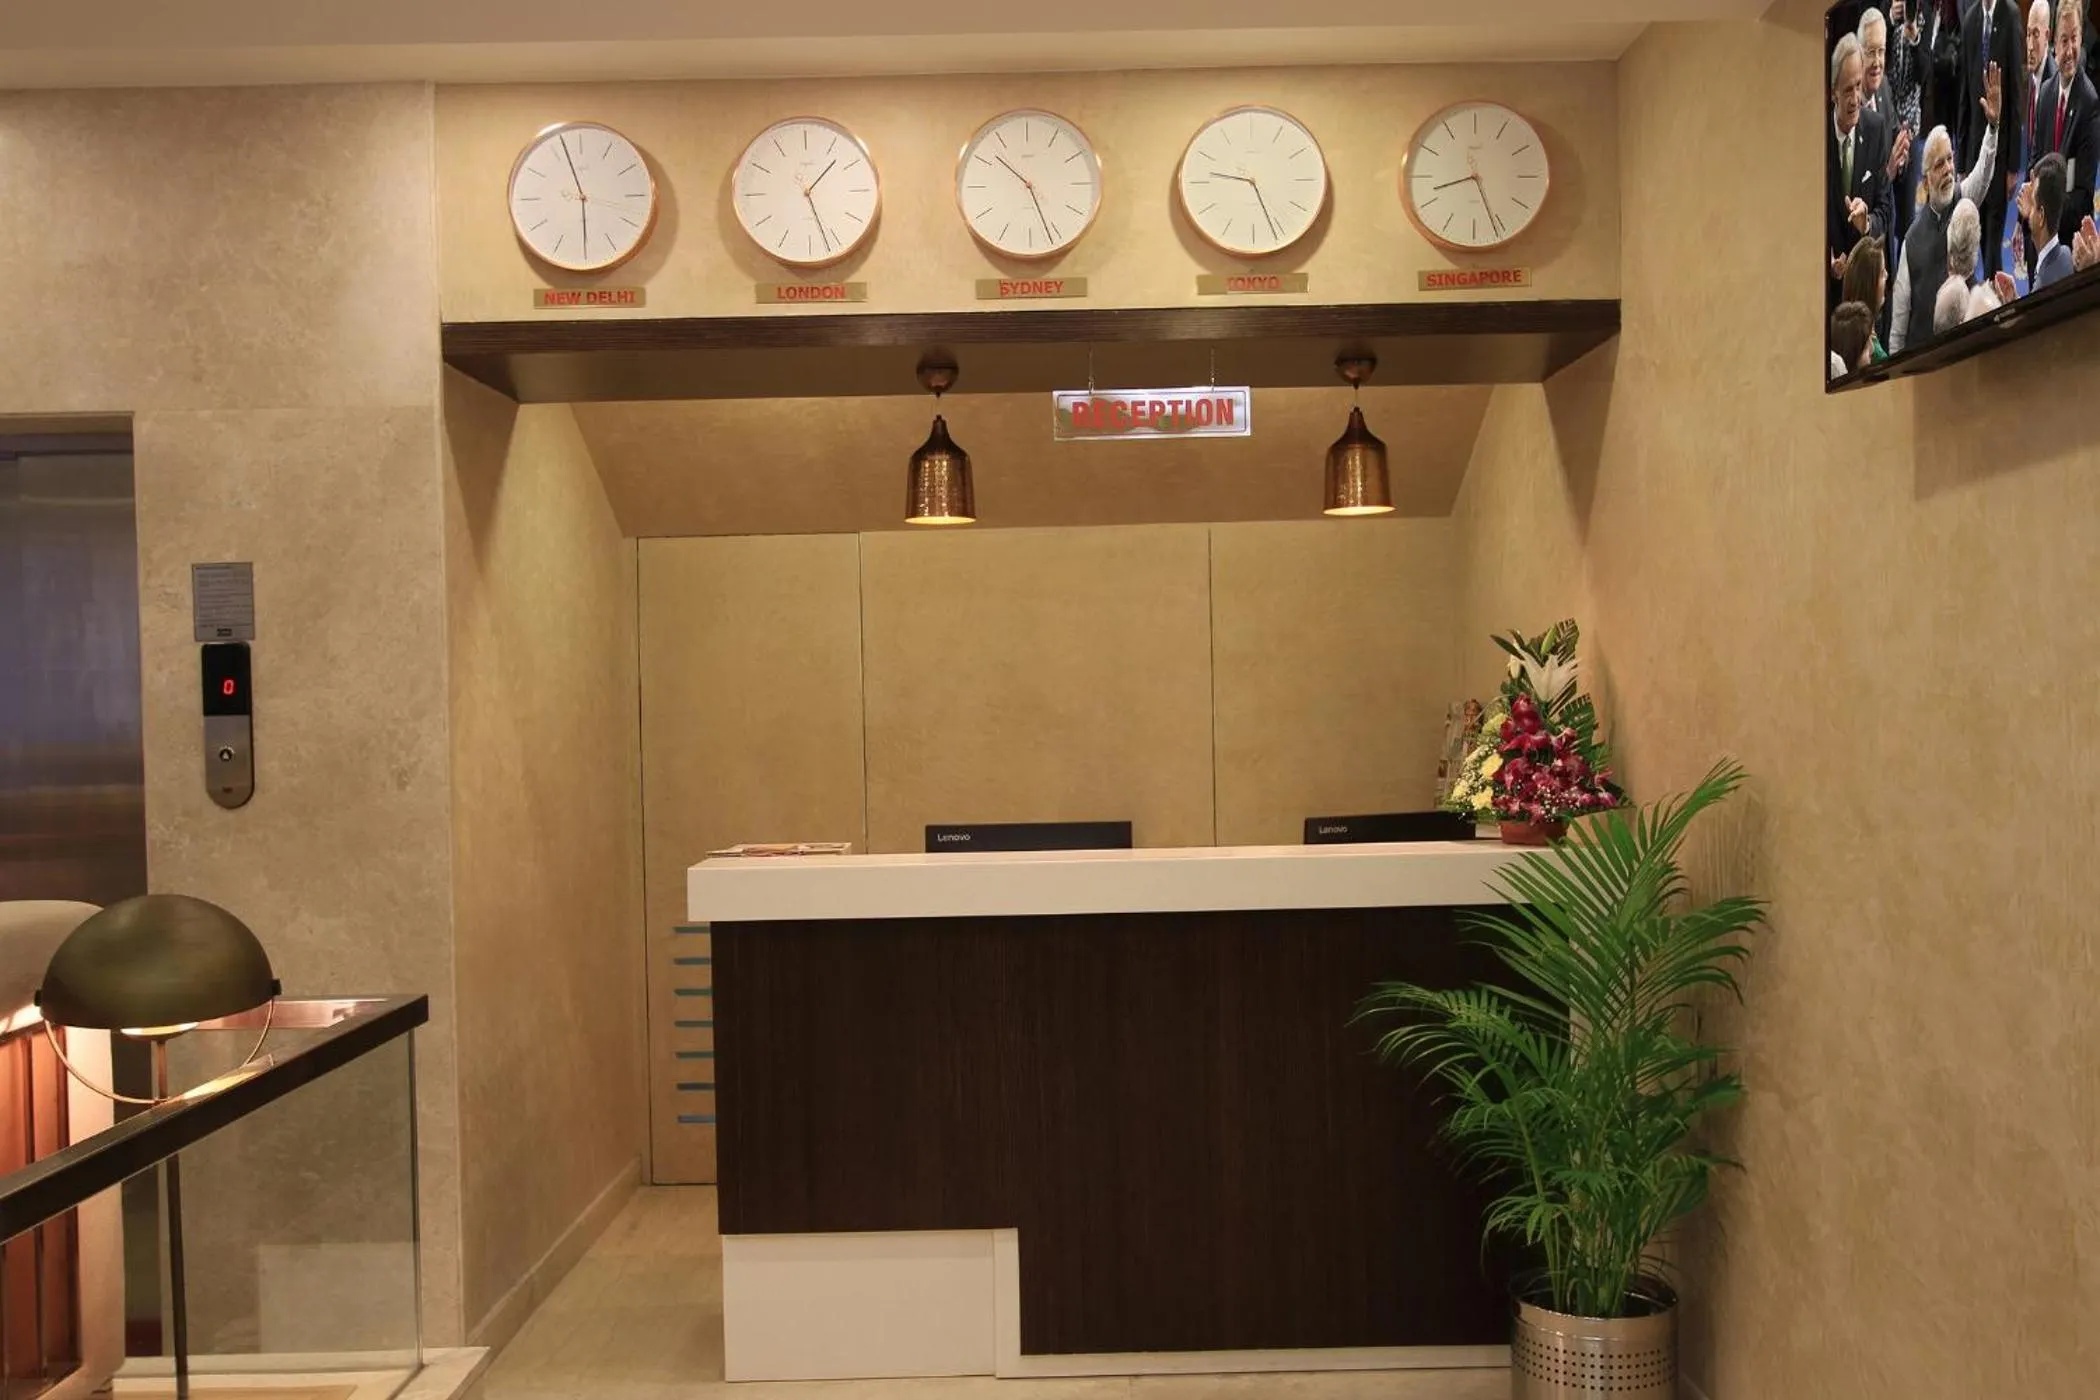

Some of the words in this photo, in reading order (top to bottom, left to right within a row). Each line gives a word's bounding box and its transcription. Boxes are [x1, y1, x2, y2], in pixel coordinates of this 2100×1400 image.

[1426, 270, 1522, 288] SINGAPORE
[777, 285, 846, 300] LONDON
[999, 280, 1064, 297] SYDNEY
[544, 292, 581, 305] NEW
[586, 291, 636, 304] DELHI
[1072, 398, 1234, 428] RECEPTION
[1319, 824, 1348, 834] Lenovo
[937, 832, 971, 842] Lenovo
